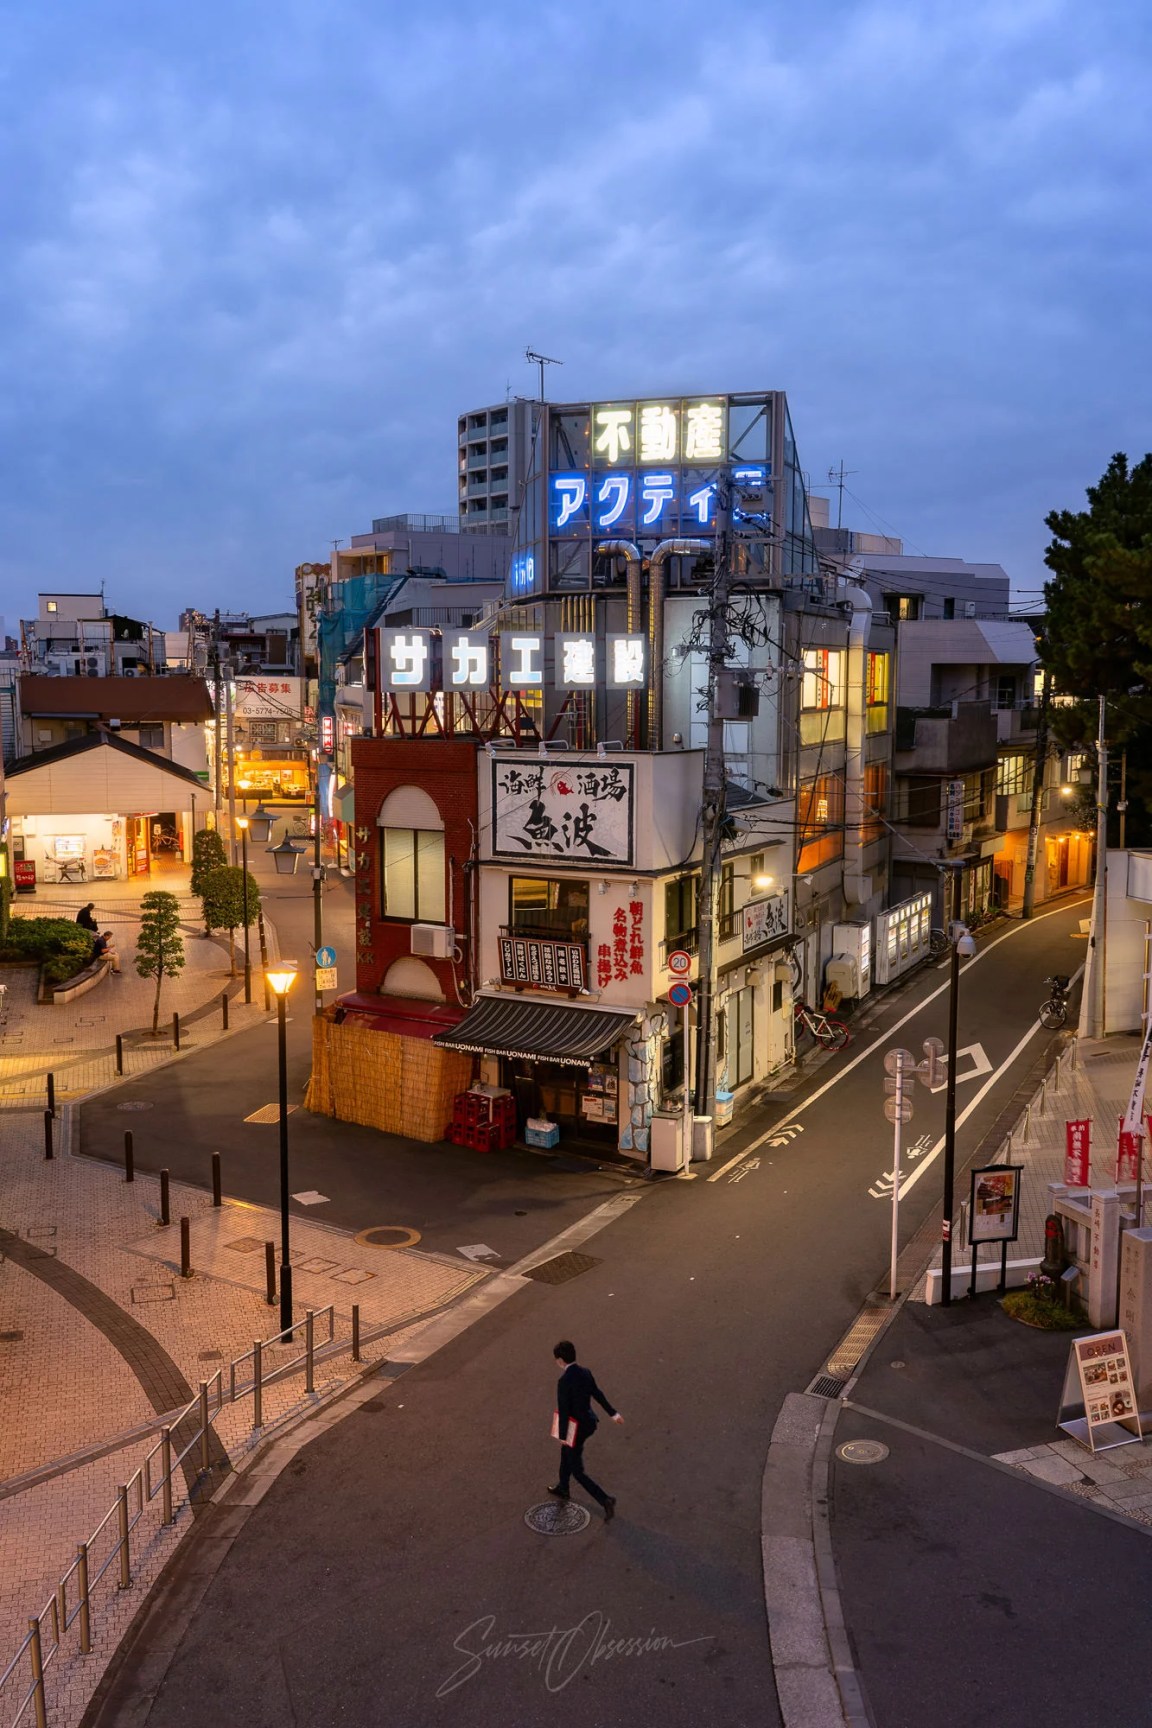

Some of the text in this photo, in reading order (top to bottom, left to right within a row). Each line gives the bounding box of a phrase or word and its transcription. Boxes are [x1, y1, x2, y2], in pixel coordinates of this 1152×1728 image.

[596, 404, 722, 463] 不動産
[390, 635, 644, 685] サカエ建設
[244, 682, 291, 693] 広告募集
[498, 766, 627, 802] 海鮮 酒場
[506, 799, 617, 857] 魚波
[613, 907, 628, 982] 名物煮込み
[629, 901, 644, 975] 朝どれ鮮魚
[597, 944, 612, 988] 串揚げ
[673, 957, 687, 968] 20
[455, 1043, 484, 1053] UONAMI
[506, 1051, 536, 1060] UONAMI
[560, 1058, 590, 1067] UONAMI
[1087, 1342, 1116, 1357] OPEN
